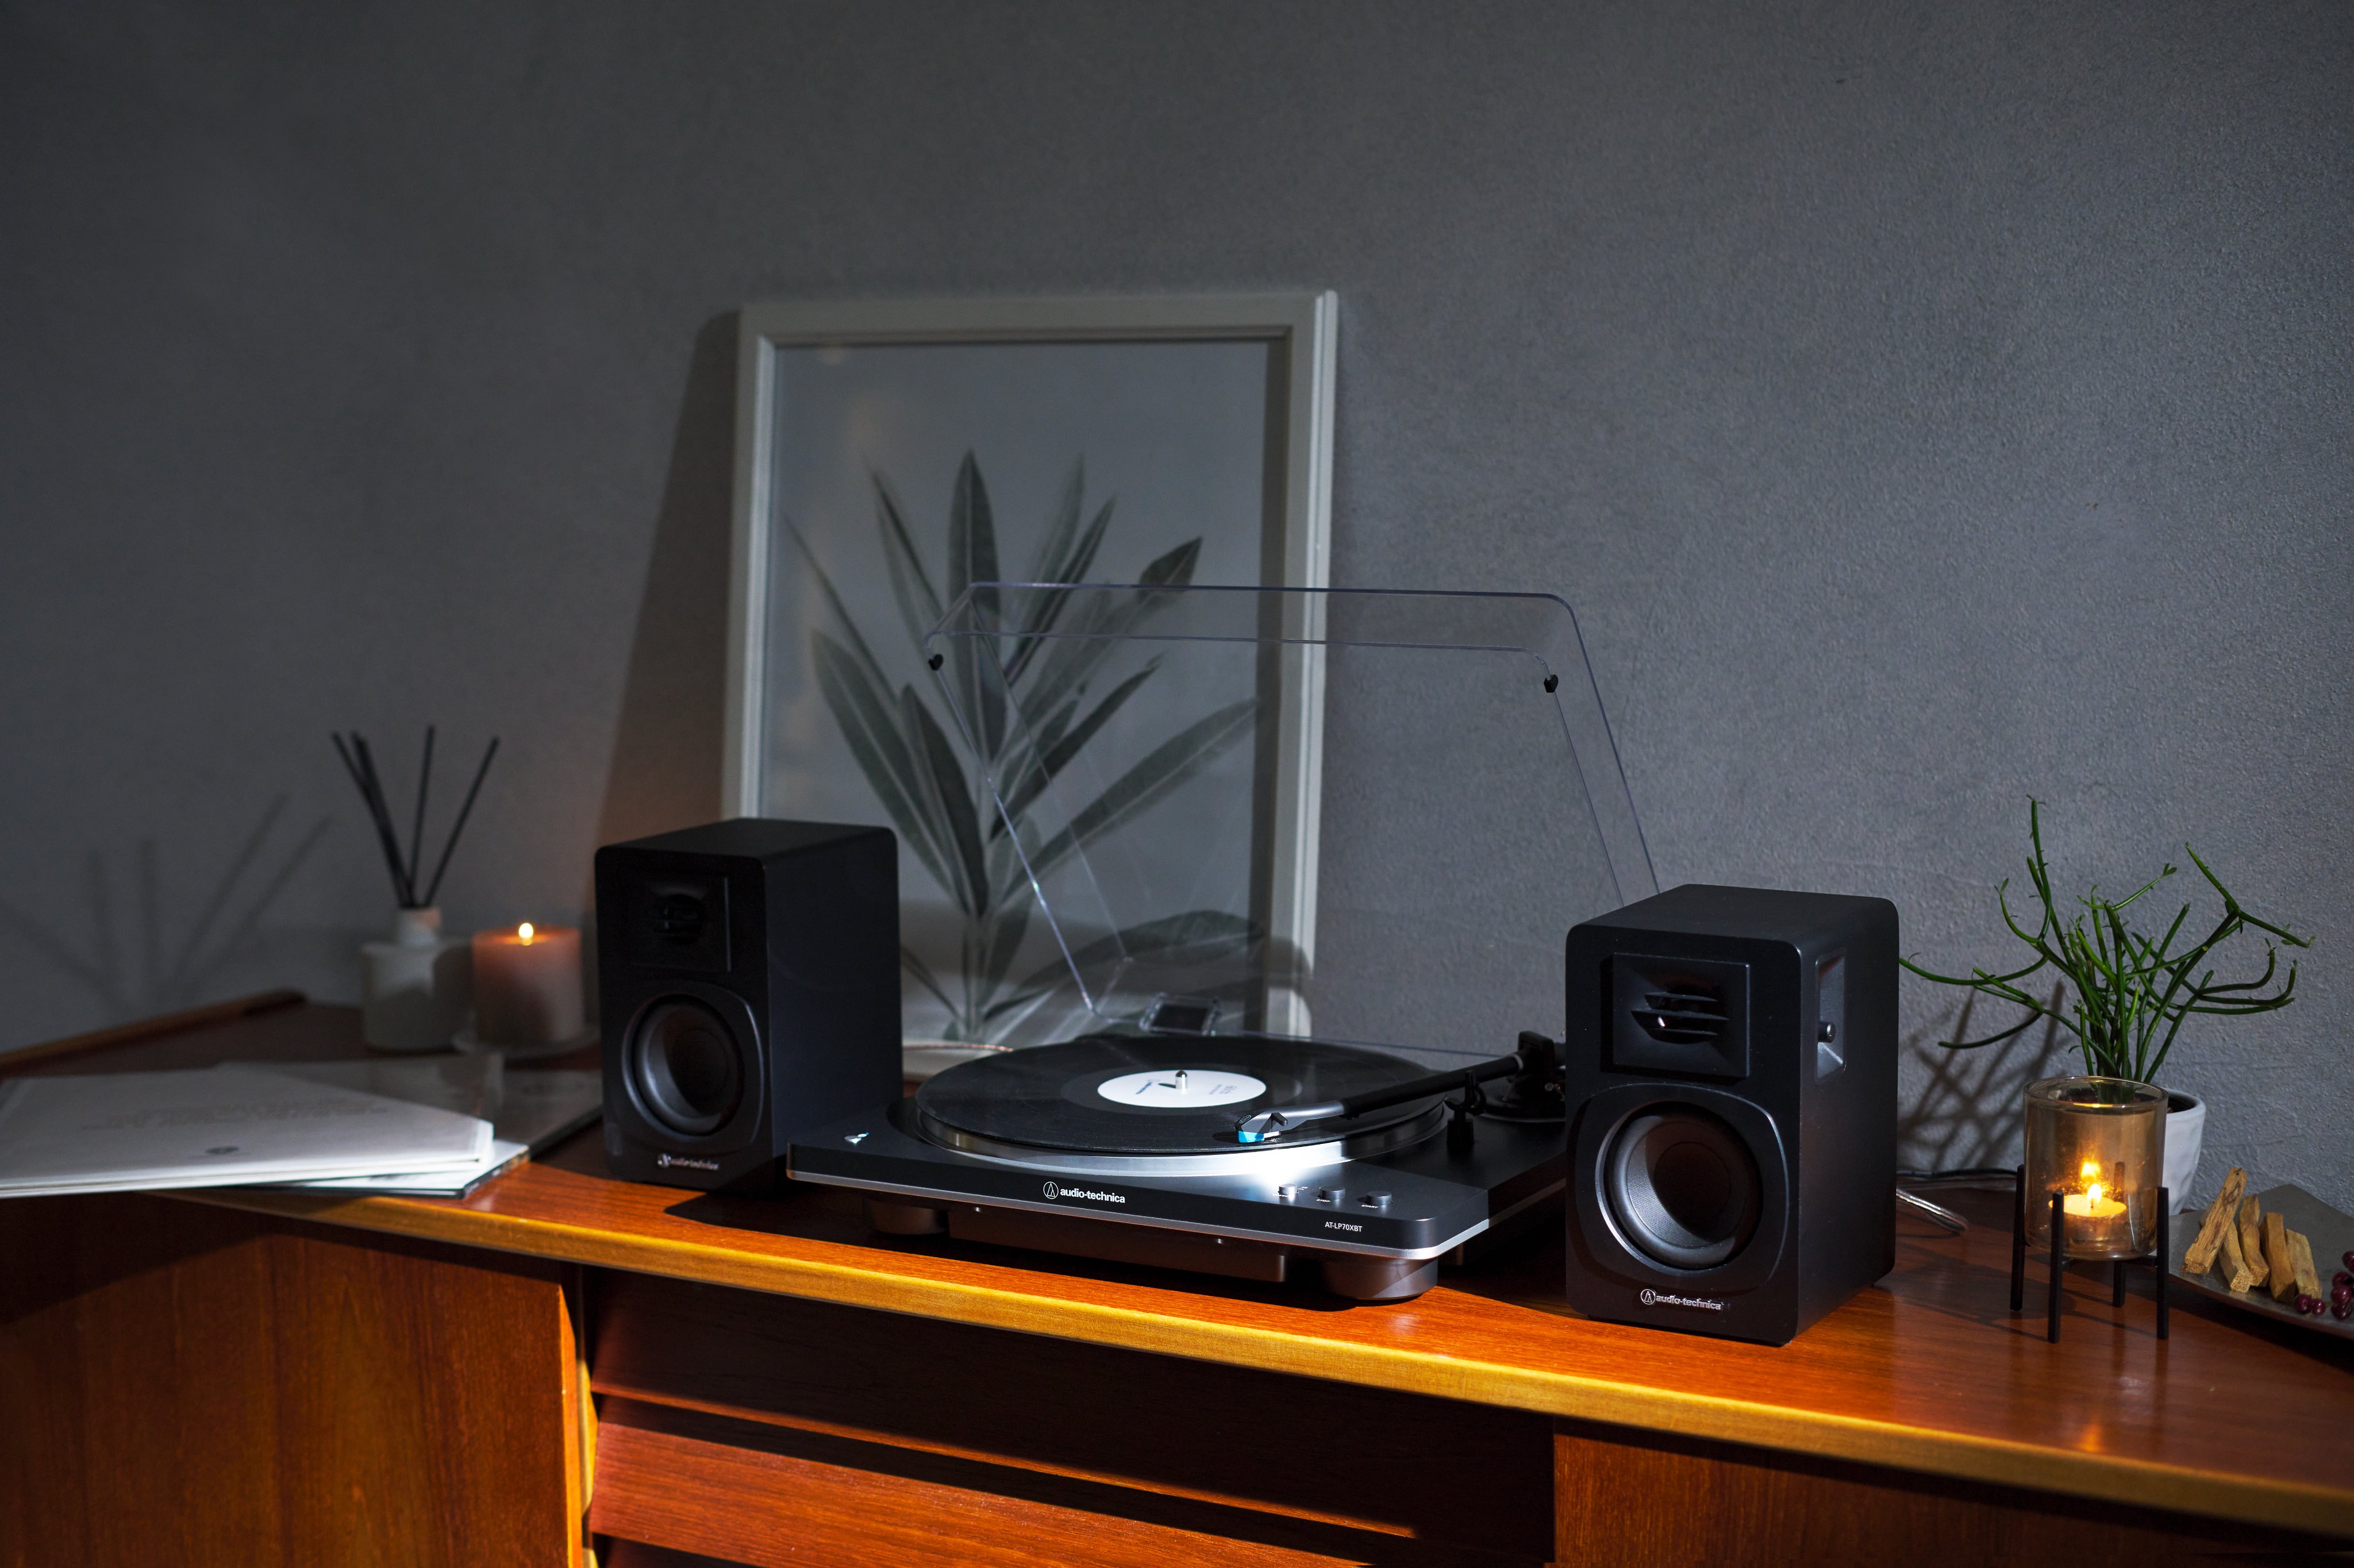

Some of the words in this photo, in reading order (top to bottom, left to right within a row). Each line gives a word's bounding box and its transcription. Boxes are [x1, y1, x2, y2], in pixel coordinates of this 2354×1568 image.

[1060, 1188, 1125, 1203] audio-technica
[1325, 1221, 1363, 1232] AT-LP70XBT
[1656, 1295, 1721, 1310] audio-technica
